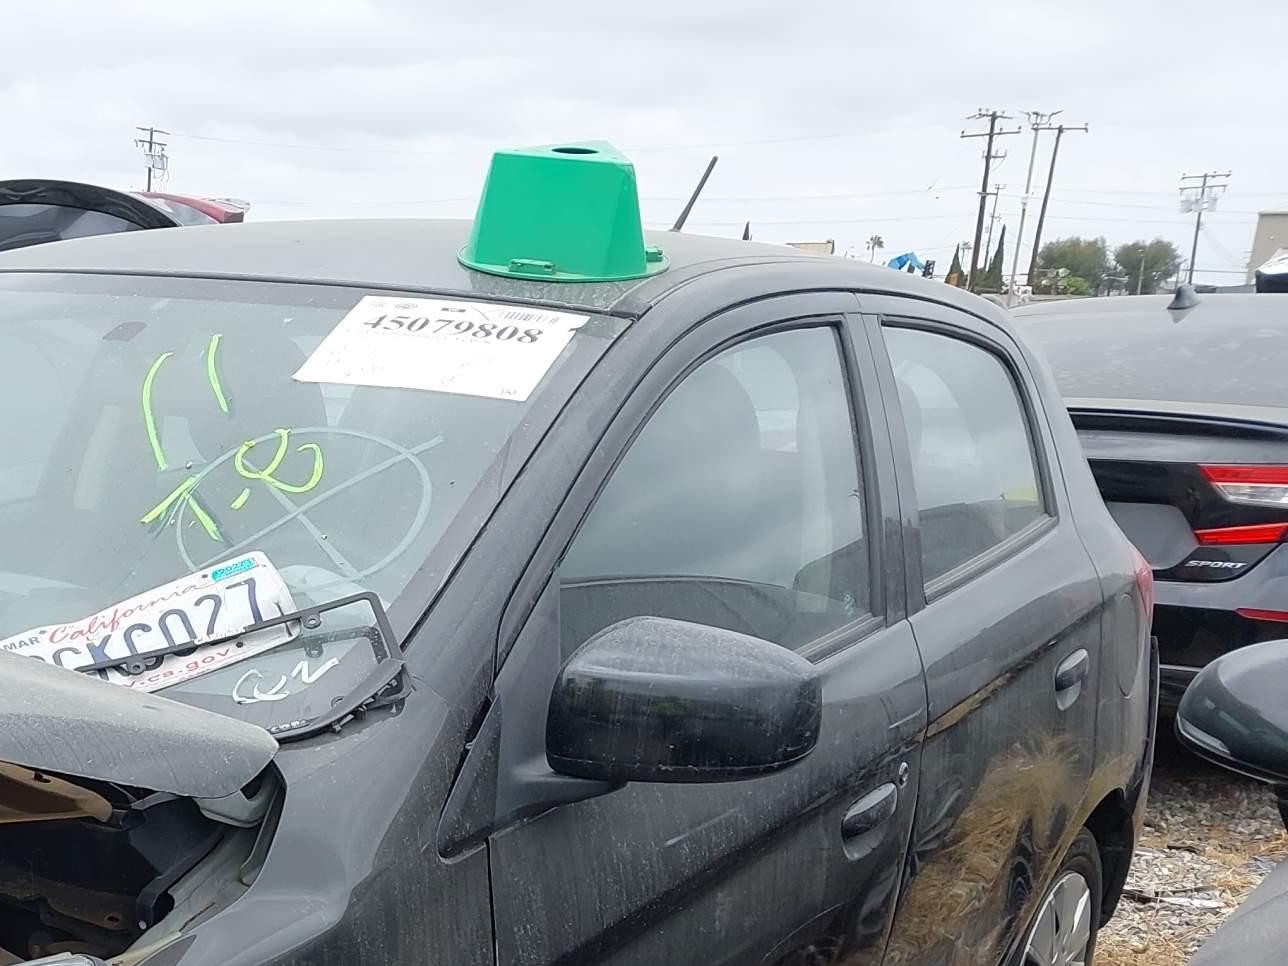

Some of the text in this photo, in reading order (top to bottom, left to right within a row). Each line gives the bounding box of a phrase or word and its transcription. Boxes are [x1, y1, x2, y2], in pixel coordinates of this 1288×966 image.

[363, 313, 544, 345] 45079808
[1185, 560, 1249, 569] SPORT
[3, 636, 40, 651] MAR
[48, 581, 204, 644] California
[28, 577, 265, 681] CKC027
